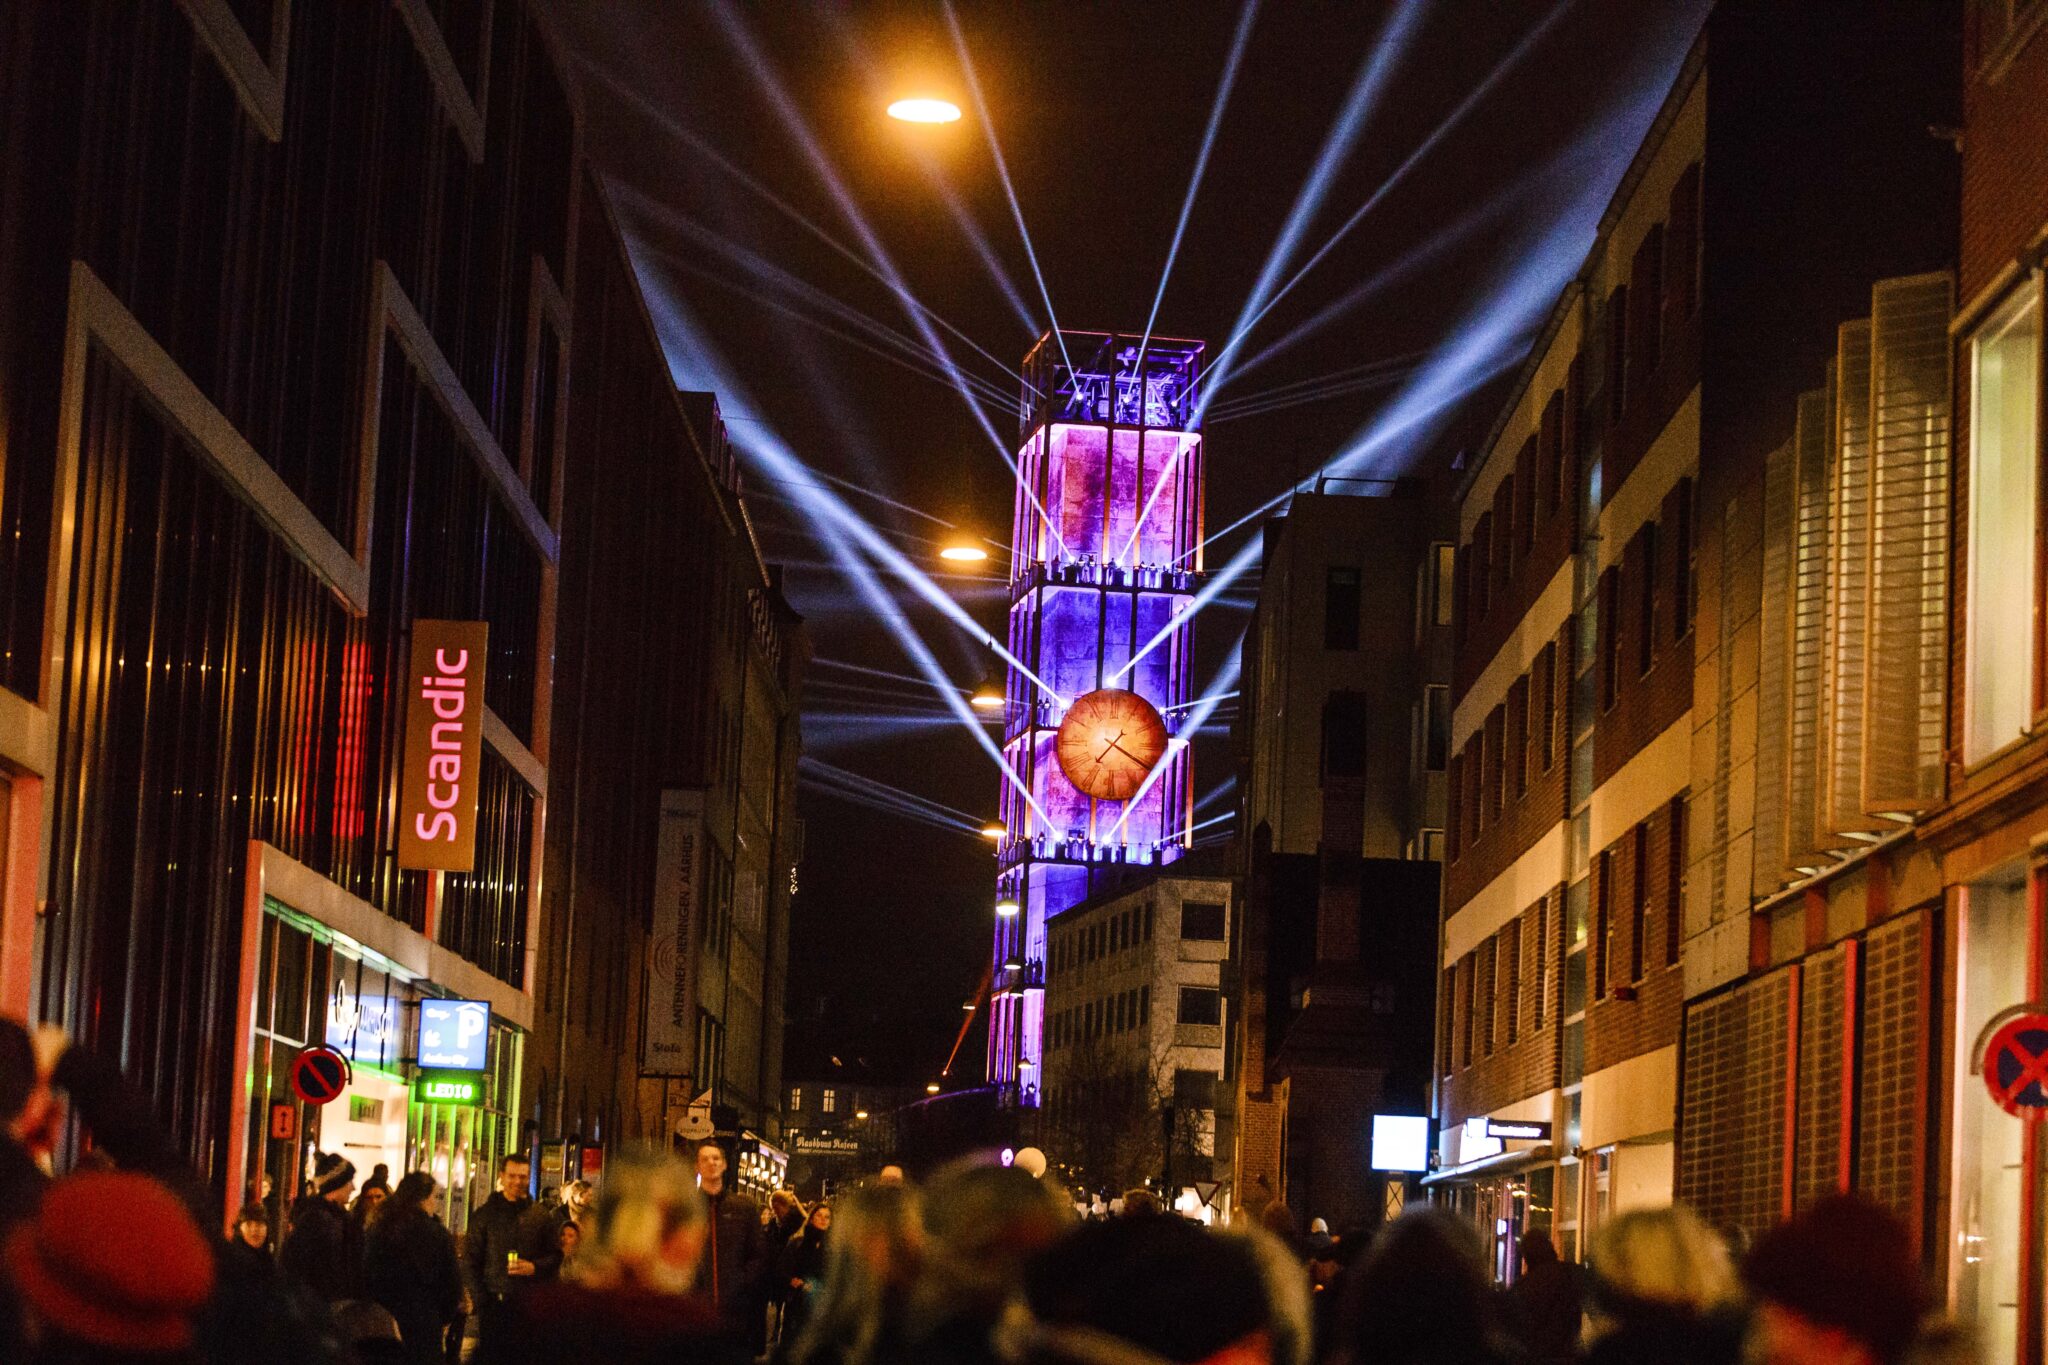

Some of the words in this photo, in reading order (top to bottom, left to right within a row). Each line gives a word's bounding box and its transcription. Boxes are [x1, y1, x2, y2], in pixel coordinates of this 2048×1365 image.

[415, 648, 468, 842] Scandic
[679, 833, 694, 885] AARHUS
[671, 890, 691, 1028] ANTENNEFORENINGEN
[457, 1009, 484, 1049] P
